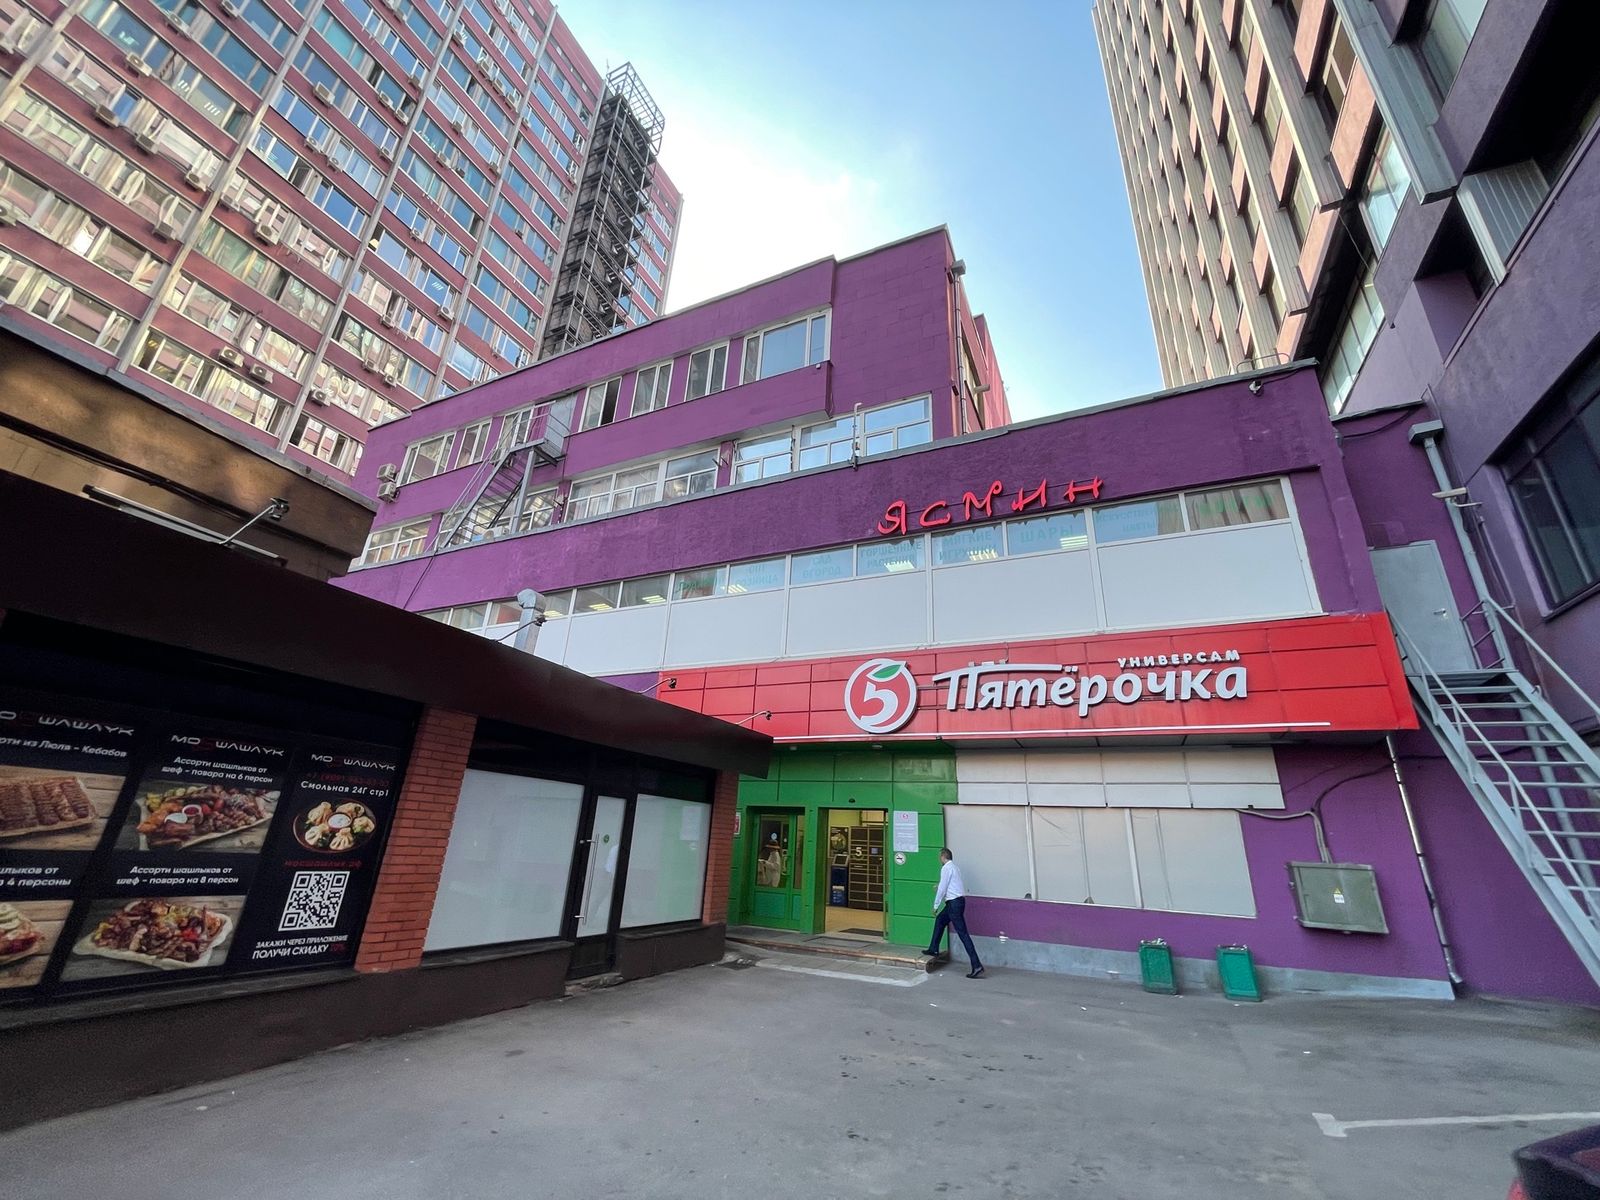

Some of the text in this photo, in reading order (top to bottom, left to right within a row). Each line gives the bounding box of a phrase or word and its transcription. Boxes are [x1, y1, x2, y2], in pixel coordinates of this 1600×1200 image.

[877, 475, 1103, 536] ЯСМИН
[943, 532, 993, 548] МЯГКИЕ
[1019, 524, 1074, 544] ШАРЫ
[1117, 649, 1241, 668] УНИВЕРСАМ
[933, 664, 1248, 717] Пятёрочка
[81, 745, 127, 757] Кебабов
[173, 756, 211, 768] Ассорти
[212, 761, 256, 772] шашлыков
[161, 766, 183, 775] шеф
[191, 769, 224, 780] повара
[237, 772, 244, 780] 6
[244, 774, 273, 785] персон
[300, 781, 389, 798] Смольная 24Г стр1
[855, 846, 862, 856] 5
[129, 865, 233, 876] Ассорти шашлыков от
[6, 877, 72, 888] 4 персоны
[115, 876, 140, 886] шеф
[148, 877, 185, 886] повара
[199, 875, 207, 884] 8
[206, 877, 239, 885] персон
[255, 934, 349, 949] ЗАКАЖИ ЧЕРЕЗ ПРИЛОЖЕНИЕ
[251, 947, 292, 960] ПОЛУЧИ
[291, 943, 330, 956] СКИДКУ
